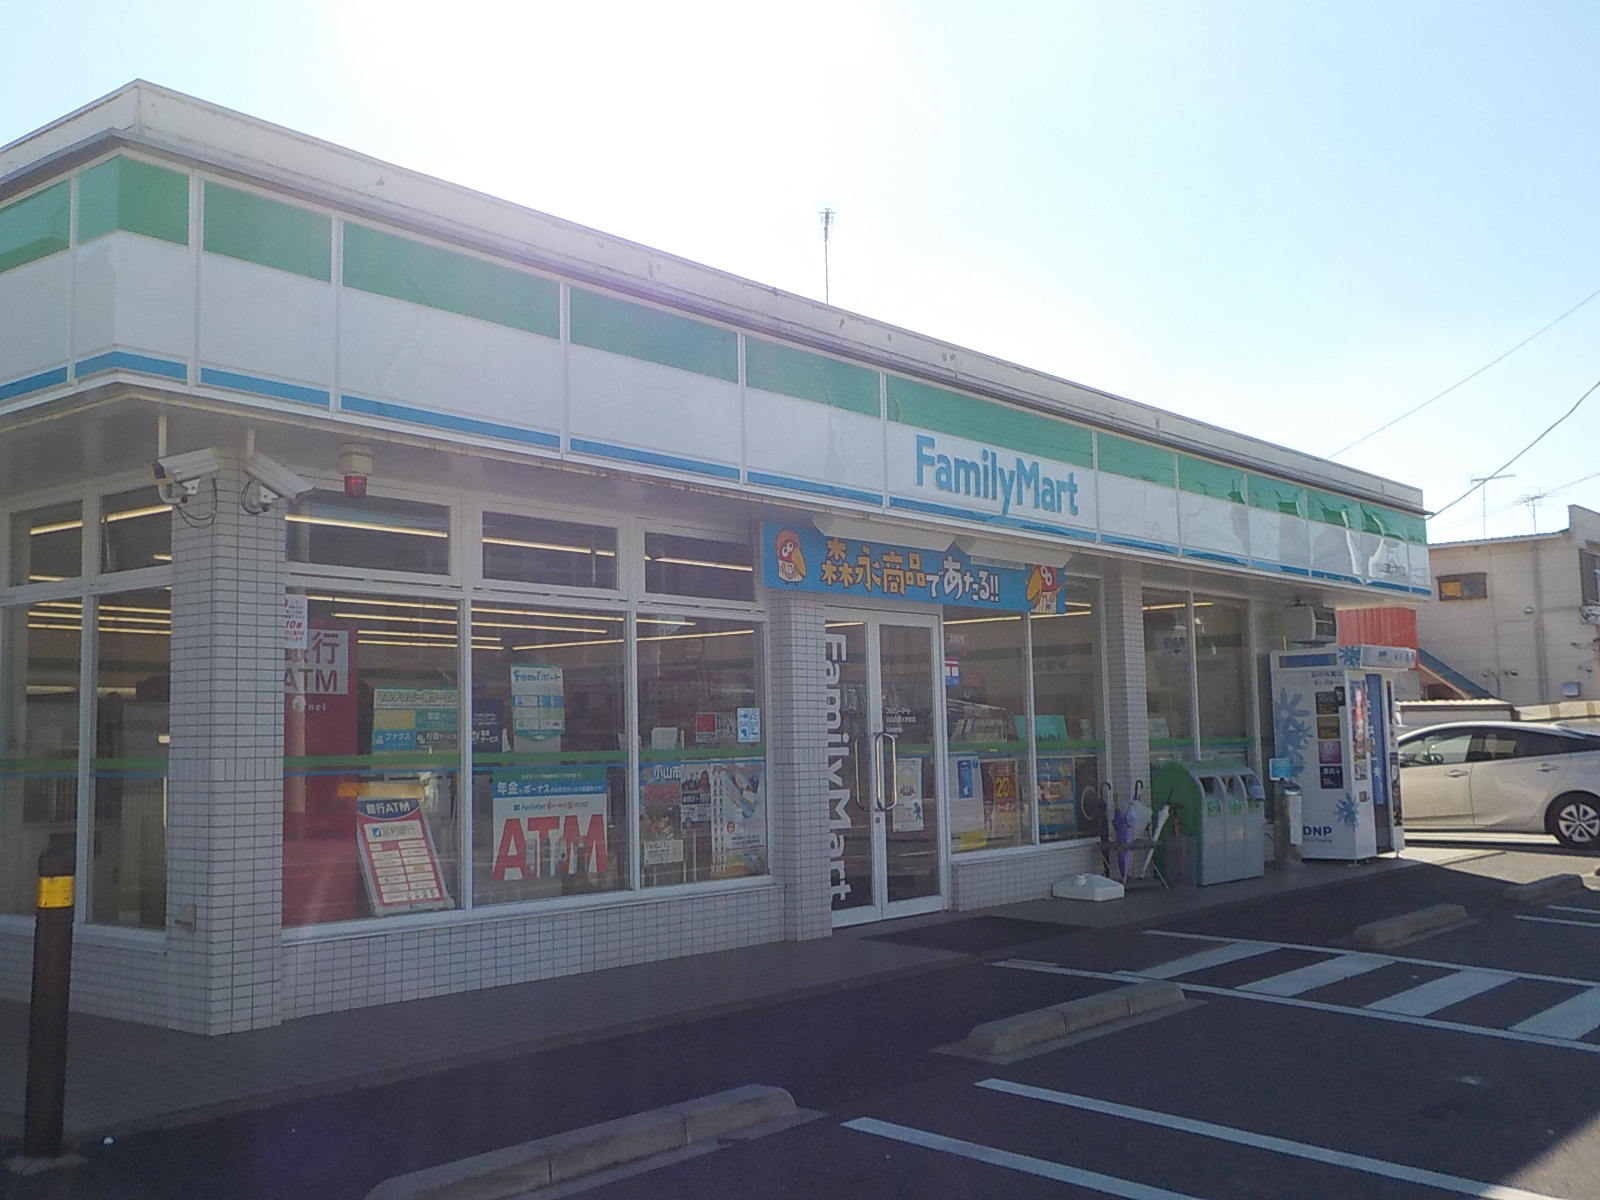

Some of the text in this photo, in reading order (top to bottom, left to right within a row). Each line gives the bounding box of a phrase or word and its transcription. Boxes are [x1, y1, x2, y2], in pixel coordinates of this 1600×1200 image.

[916, 434, 1080, 517] FamilyMart
[820, 537, 1000, 602] 森永商品であたる!!
[284, 668, 338, 692] ATM
[825, 633, 852, 901] FamilyMart
[492, 813, 608, 881] ATM
[1303, 825, 1333, 837] DNP
